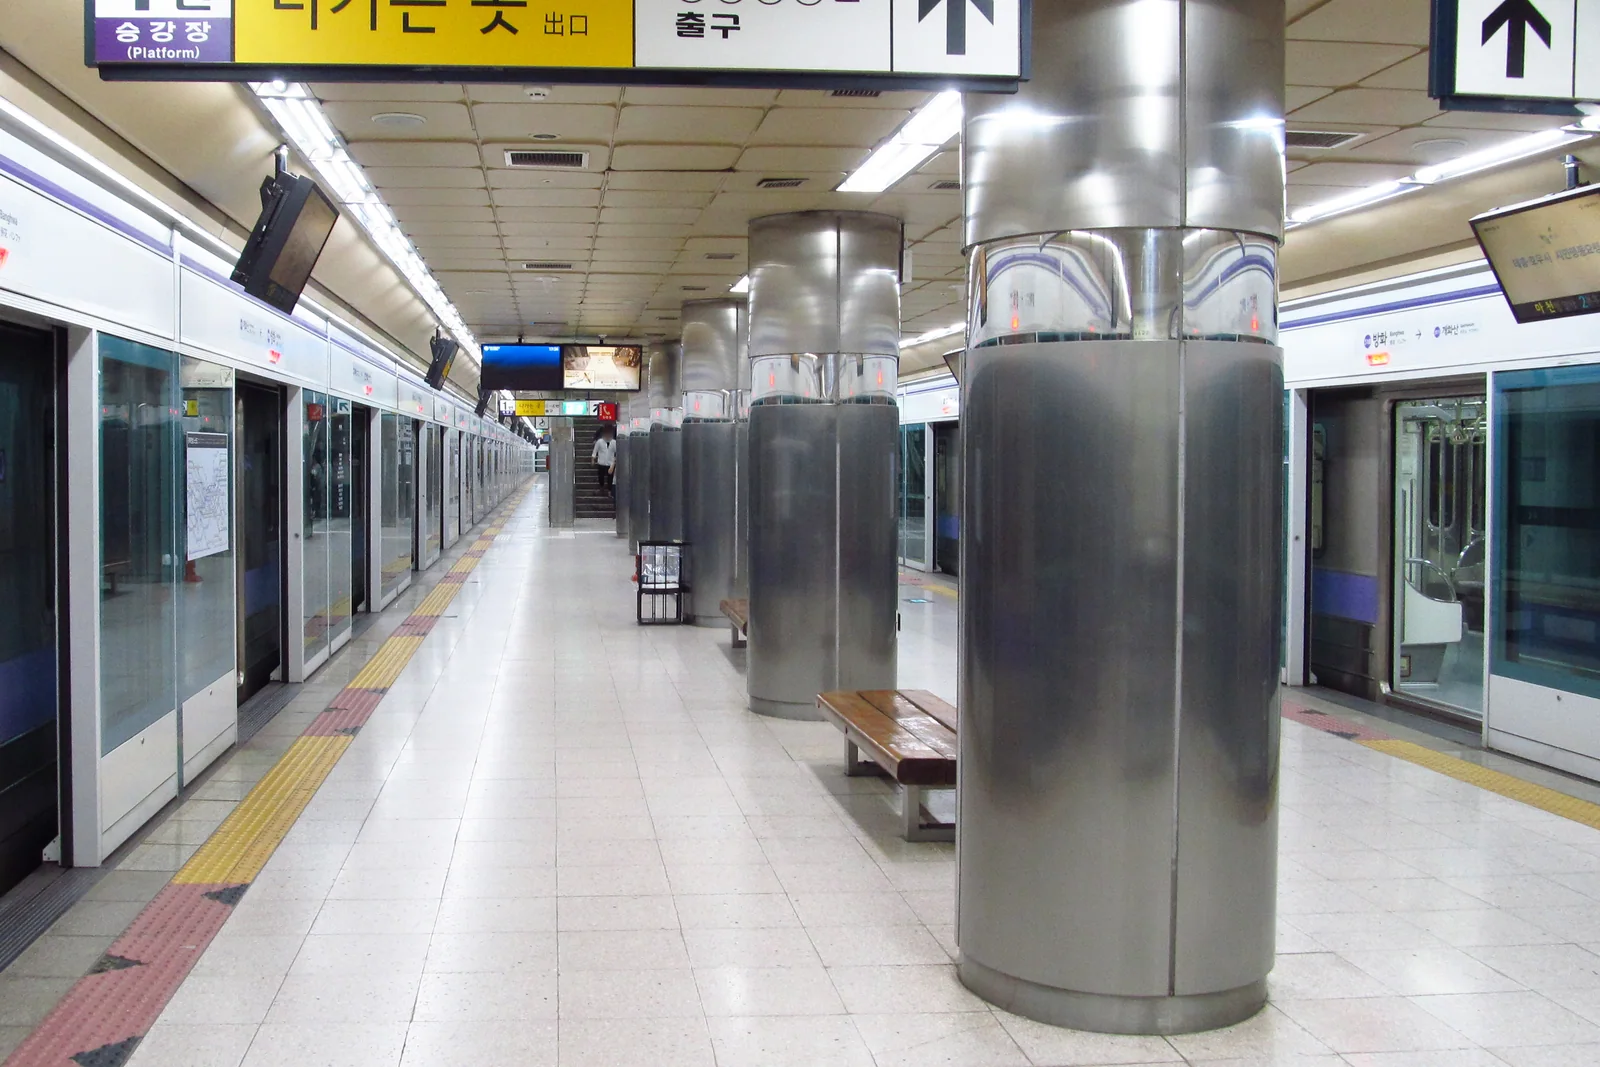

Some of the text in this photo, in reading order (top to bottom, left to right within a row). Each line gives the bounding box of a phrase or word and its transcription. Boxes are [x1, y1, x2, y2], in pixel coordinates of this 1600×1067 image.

[115, 21, 212, 43] 승강장
[544, 11, 588, 37] 出口
[675, 11, 741, 40] 출구
[127, 46, 201, 60] (Platform)
[1373, 331, 1388, 348] 방화
